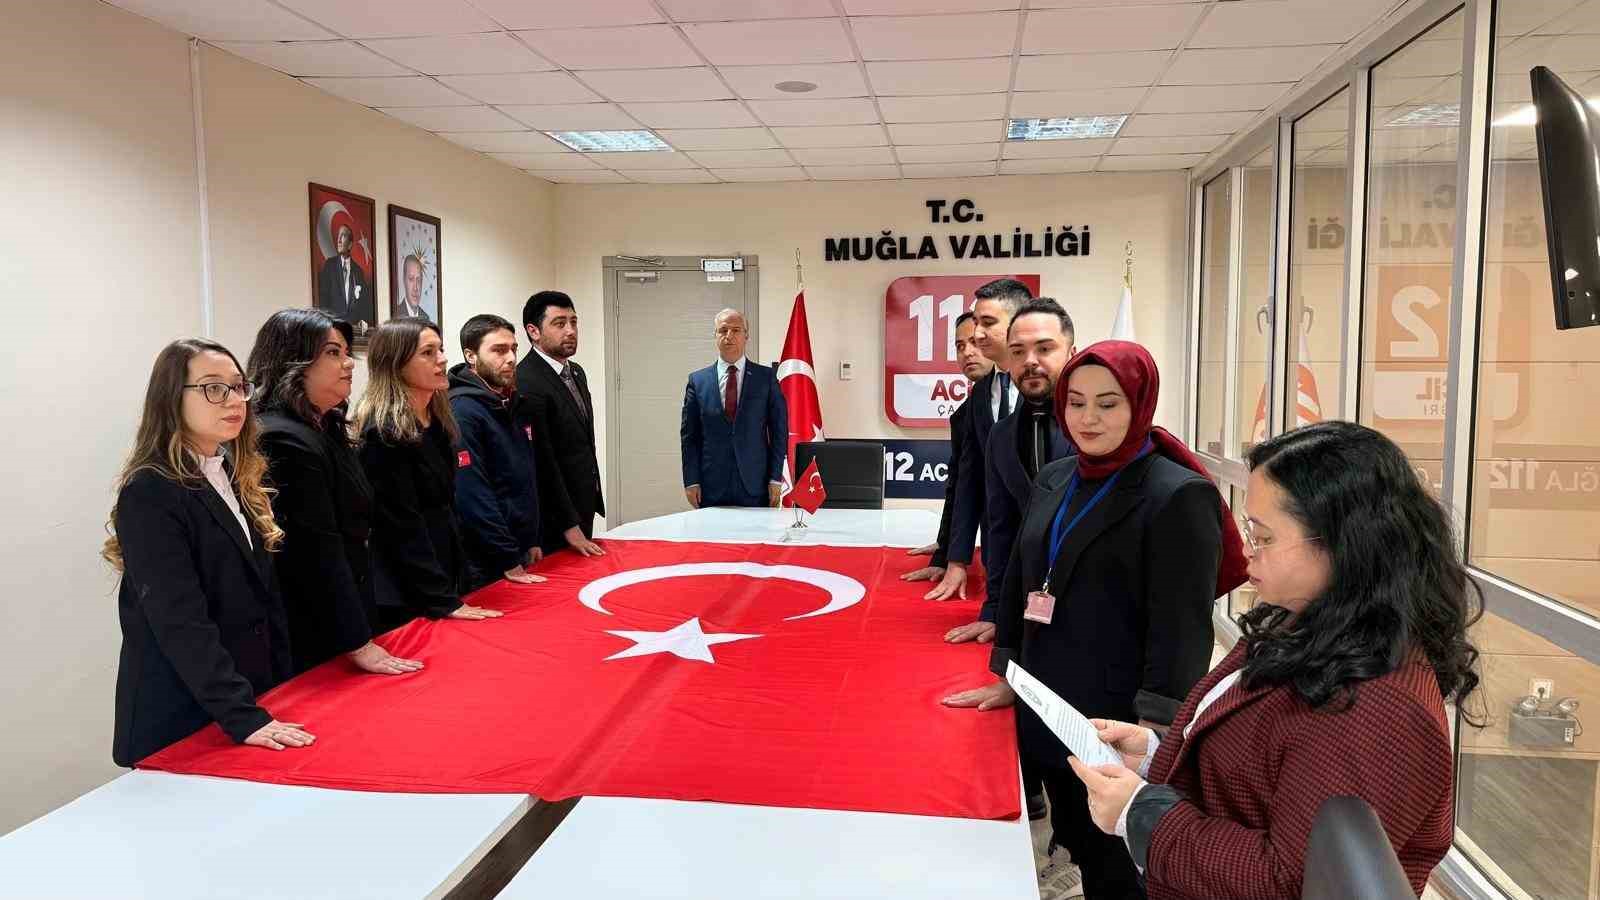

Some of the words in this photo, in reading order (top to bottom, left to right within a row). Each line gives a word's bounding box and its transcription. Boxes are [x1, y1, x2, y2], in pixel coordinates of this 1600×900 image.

[926, 199, 984, 223] T.C.
[825, 230, 939, 261] MUĞLA
[949, 225, 1091, 259] VALİLİĞİ
[909, 294, 977, 361] 11
[931, 379, 975, 401] AC
[885, 451, 914, 481] 12
[919, 463, 949, 482] AC
